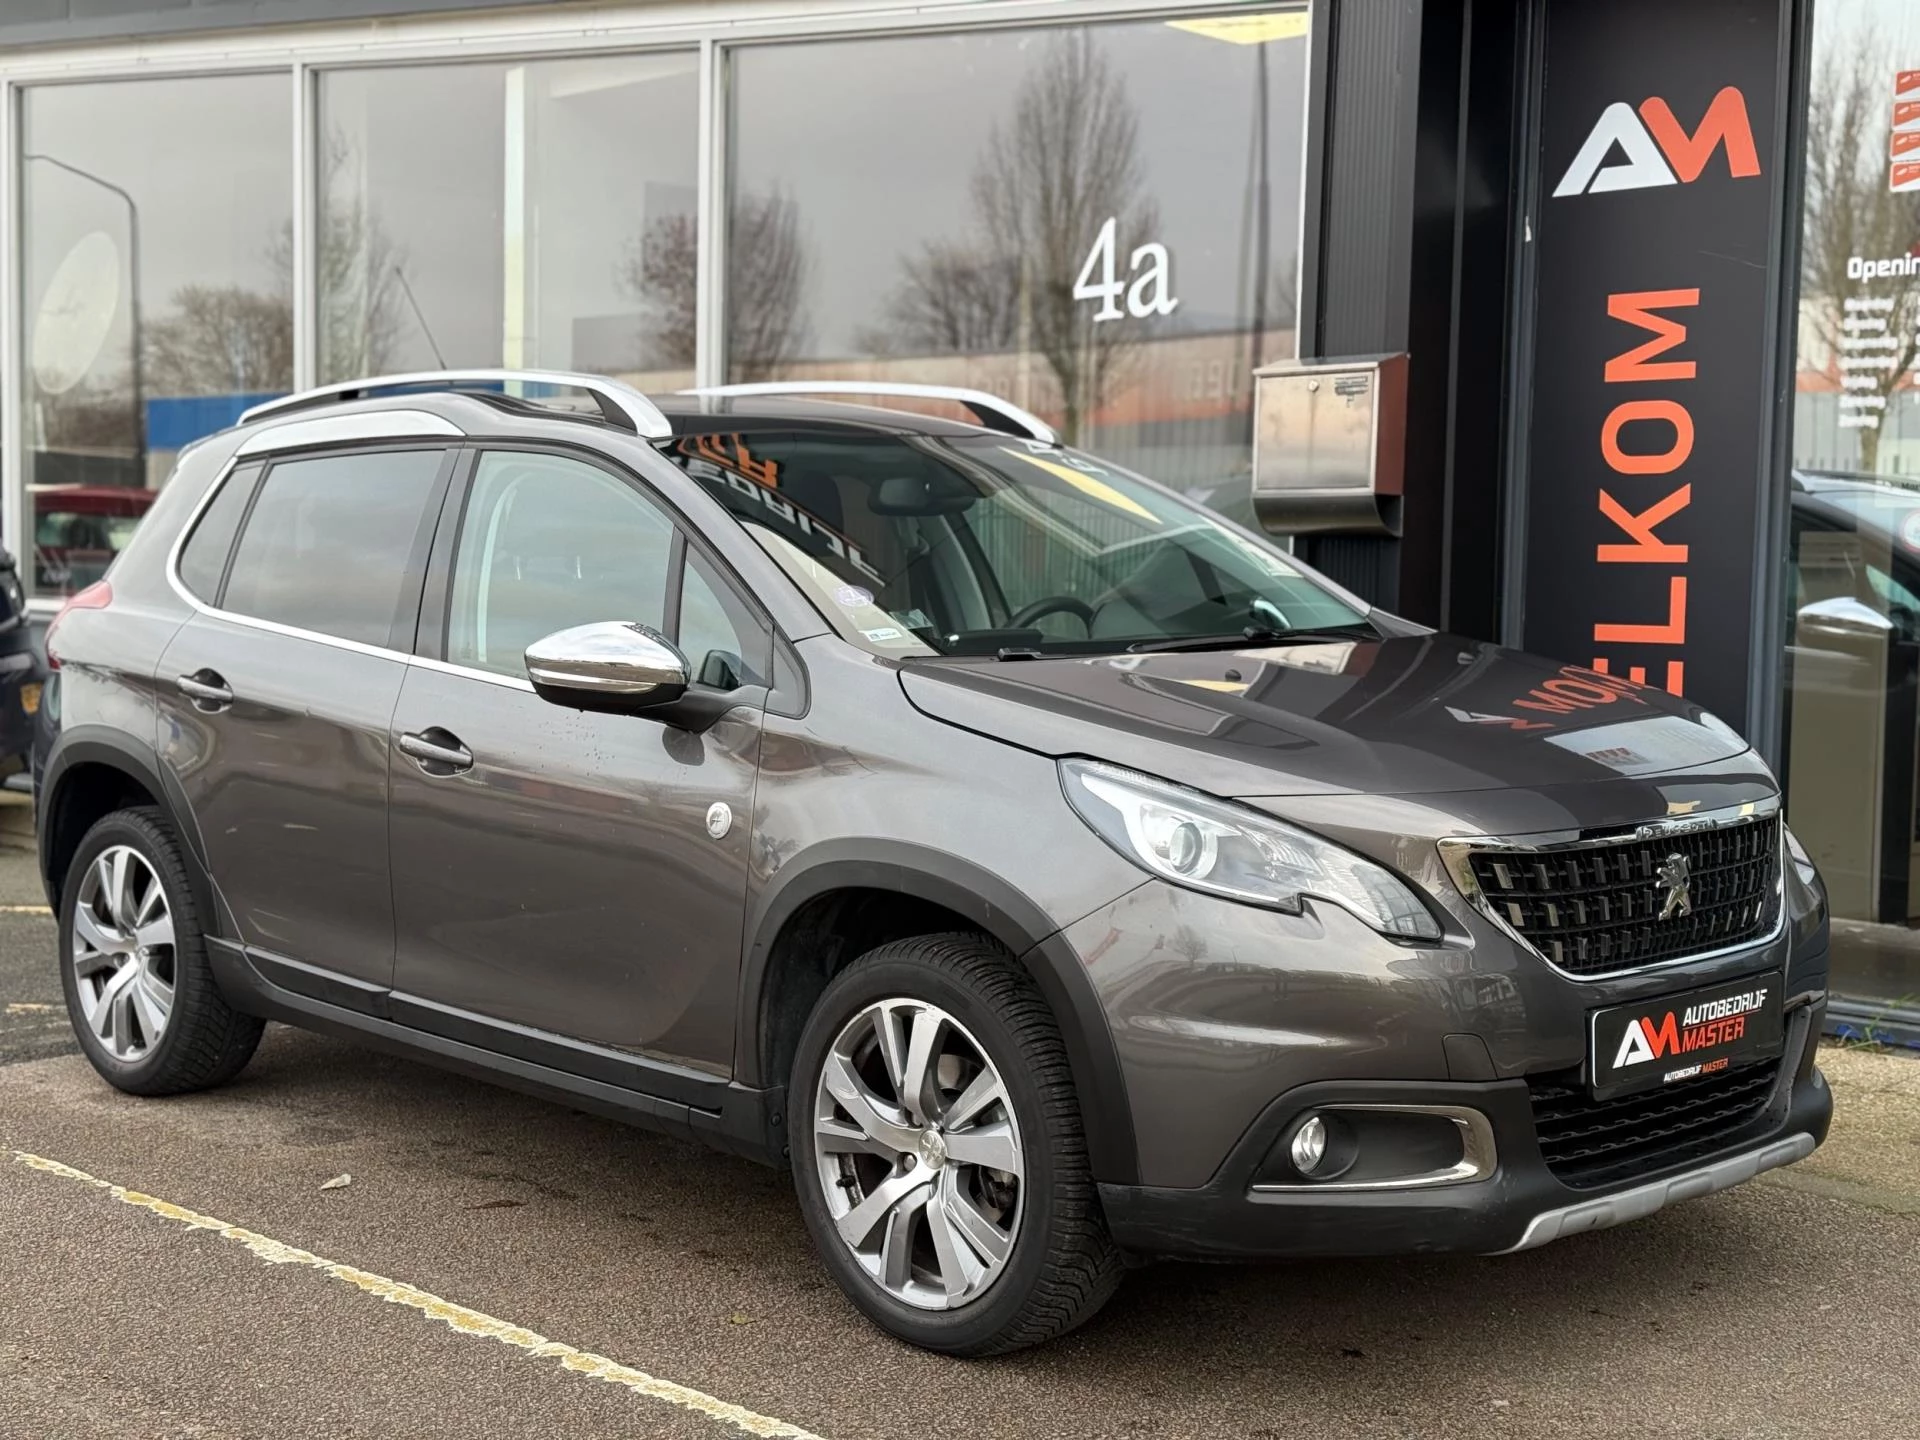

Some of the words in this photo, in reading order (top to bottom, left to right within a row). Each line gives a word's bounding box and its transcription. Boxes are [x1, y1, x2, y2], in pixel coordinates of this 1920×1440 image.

[1552, 86, 1761, 197] AM
[1073, 216, 1179, 322] 4a
[1593, 288, 1700, 698] LKOM
[1682, 988, 1768, 1027] AUTOBEDRIJF
[1682, 1016, 1745, 1053] MASTER
[1612, 1011, 1681, 1069] AM
[1664, 1064, 1702, 1083] AUTOBEDRIJF
[1701, 1058, 1729, 1075] MASTER
